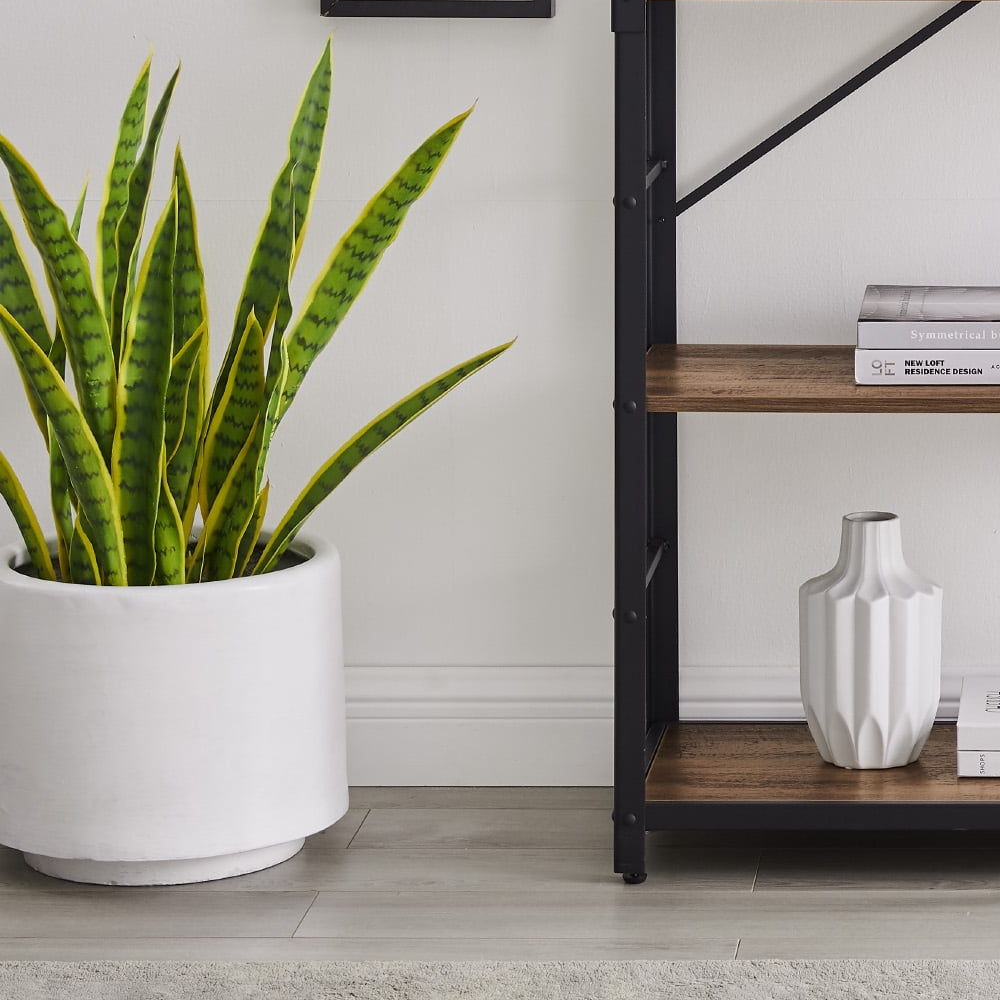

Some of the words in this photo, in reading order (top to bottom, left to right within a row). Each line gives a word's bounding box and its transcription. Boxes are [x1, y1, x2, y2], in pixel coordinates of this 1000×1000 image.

[910, 329, 986, 342] Symmetrical
[904, 359, 924, 367] NEW
[925, 359, 945, 367] LOFT
[904, 367, 951, 375] RESIDENCE
[952, 367, 983, 375] DESIGN
